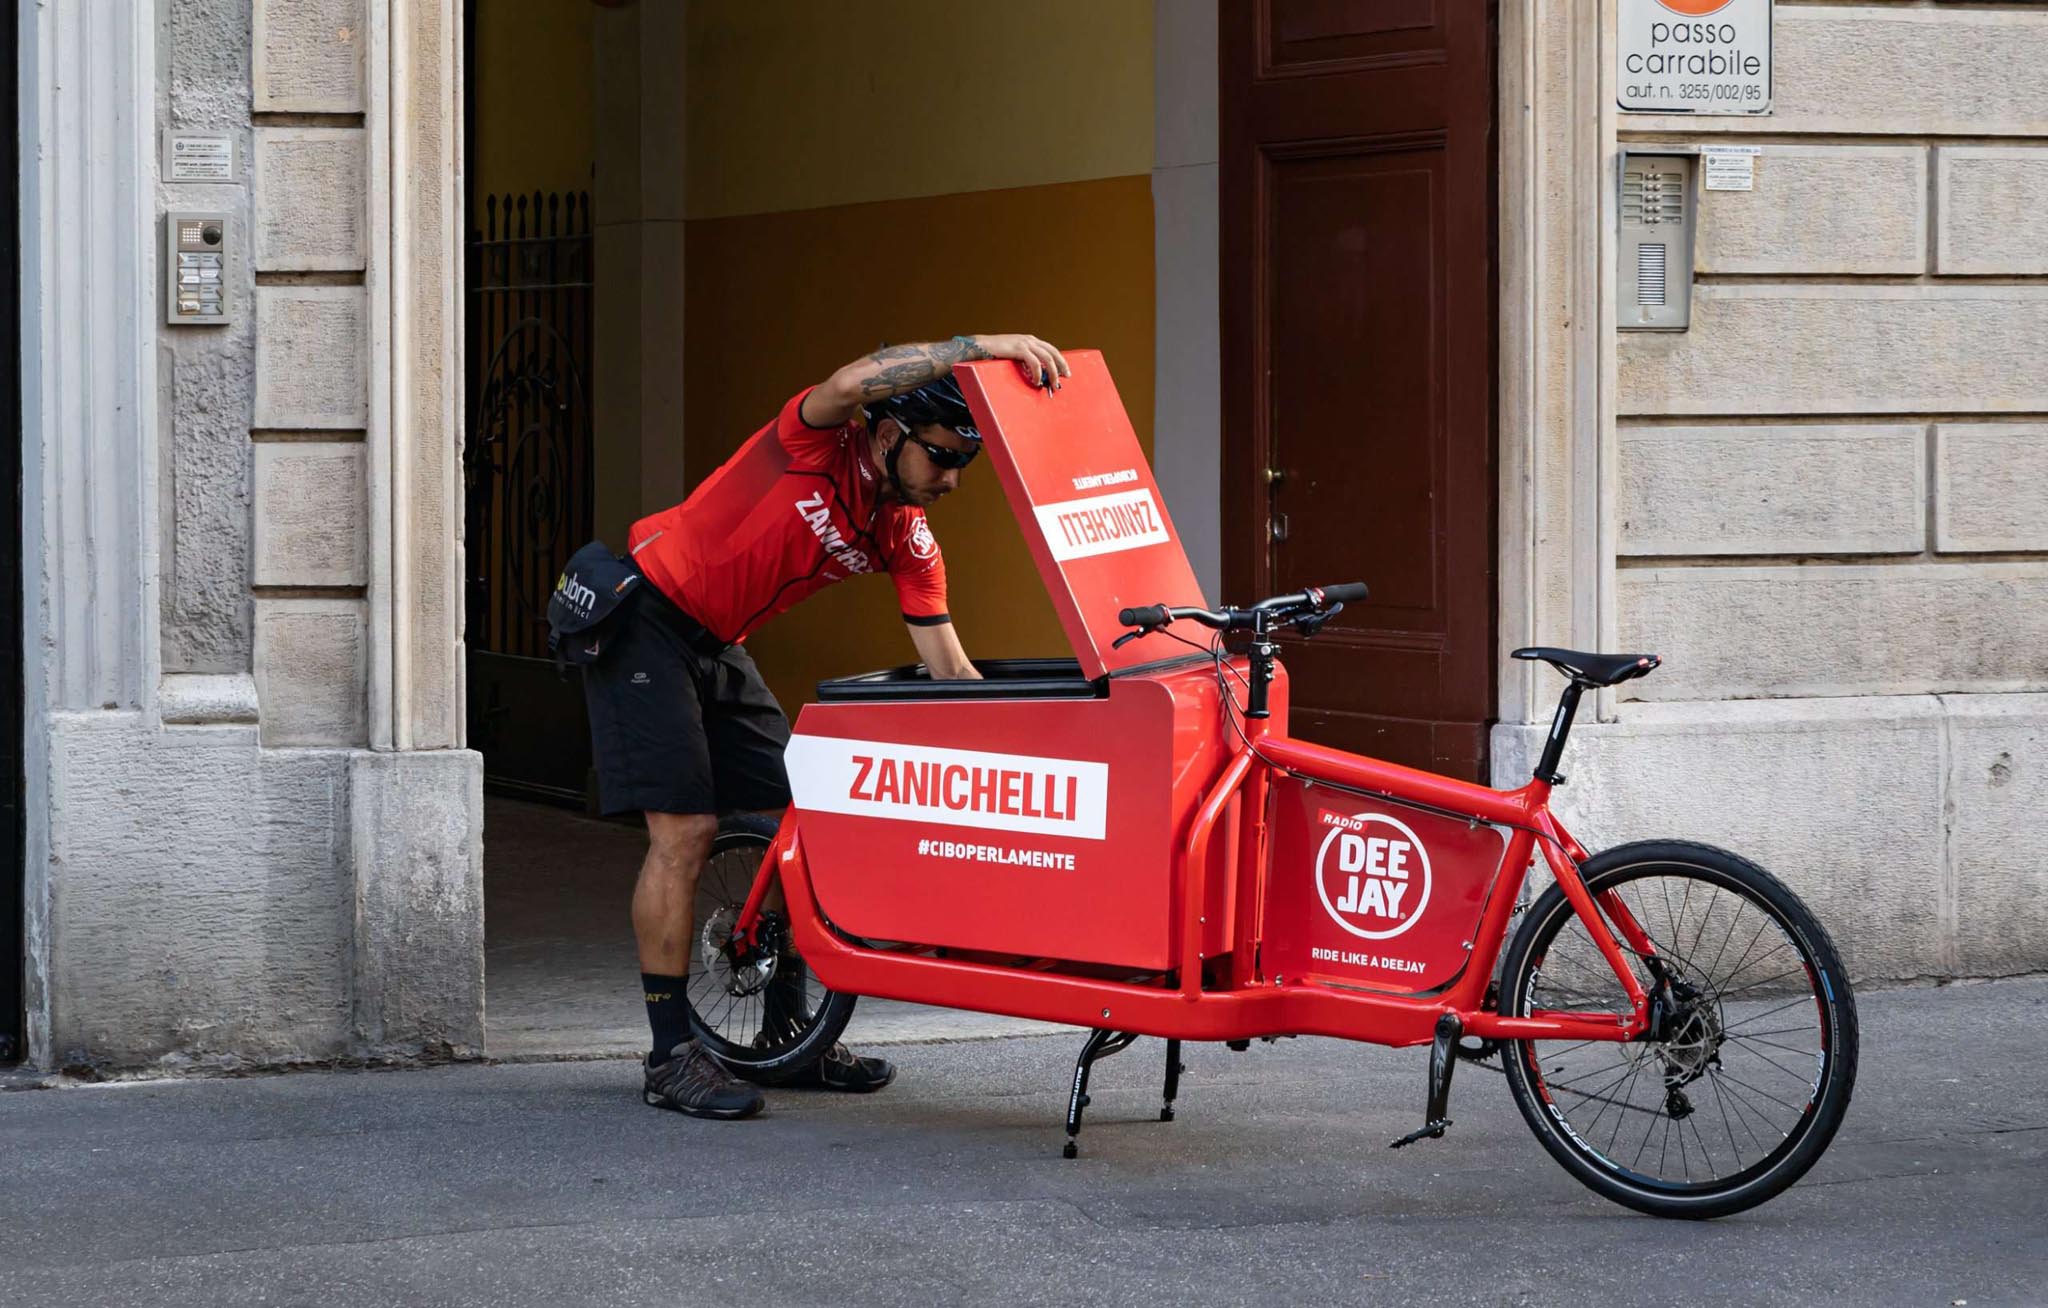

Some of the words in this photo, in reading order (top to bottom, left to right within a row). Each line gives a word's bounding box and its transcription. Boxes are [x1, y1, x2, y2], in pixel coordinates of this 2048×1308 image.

[1652, 22, 1736, 48] passo
[1626, 49, 1761, 76] carrabile
[1626, 83, 1657, 98] aut.
[1660, 85, 1674, 98] n.
[1679, 83, 1761, 103] 3255/002/95
[1057, 500, 1159, 548] ZANICHELLI
[849, 755, 1077, 821] ZANICHELLI
[1323, 813, 1364, 831] RADIO
[918, 839, 1075, 870] #CIBOPERLAMENTE
[1339, 833, 1411, 880] DEE
[1337, 876, 1409, 919] JAY
[1312, 947, 1339, 962] RIDE
[1341, 951, 1368, 966] LIKE
[1370, 957, 1379, 968] A
[1381, 958, 1426, 974] DEEJAY
